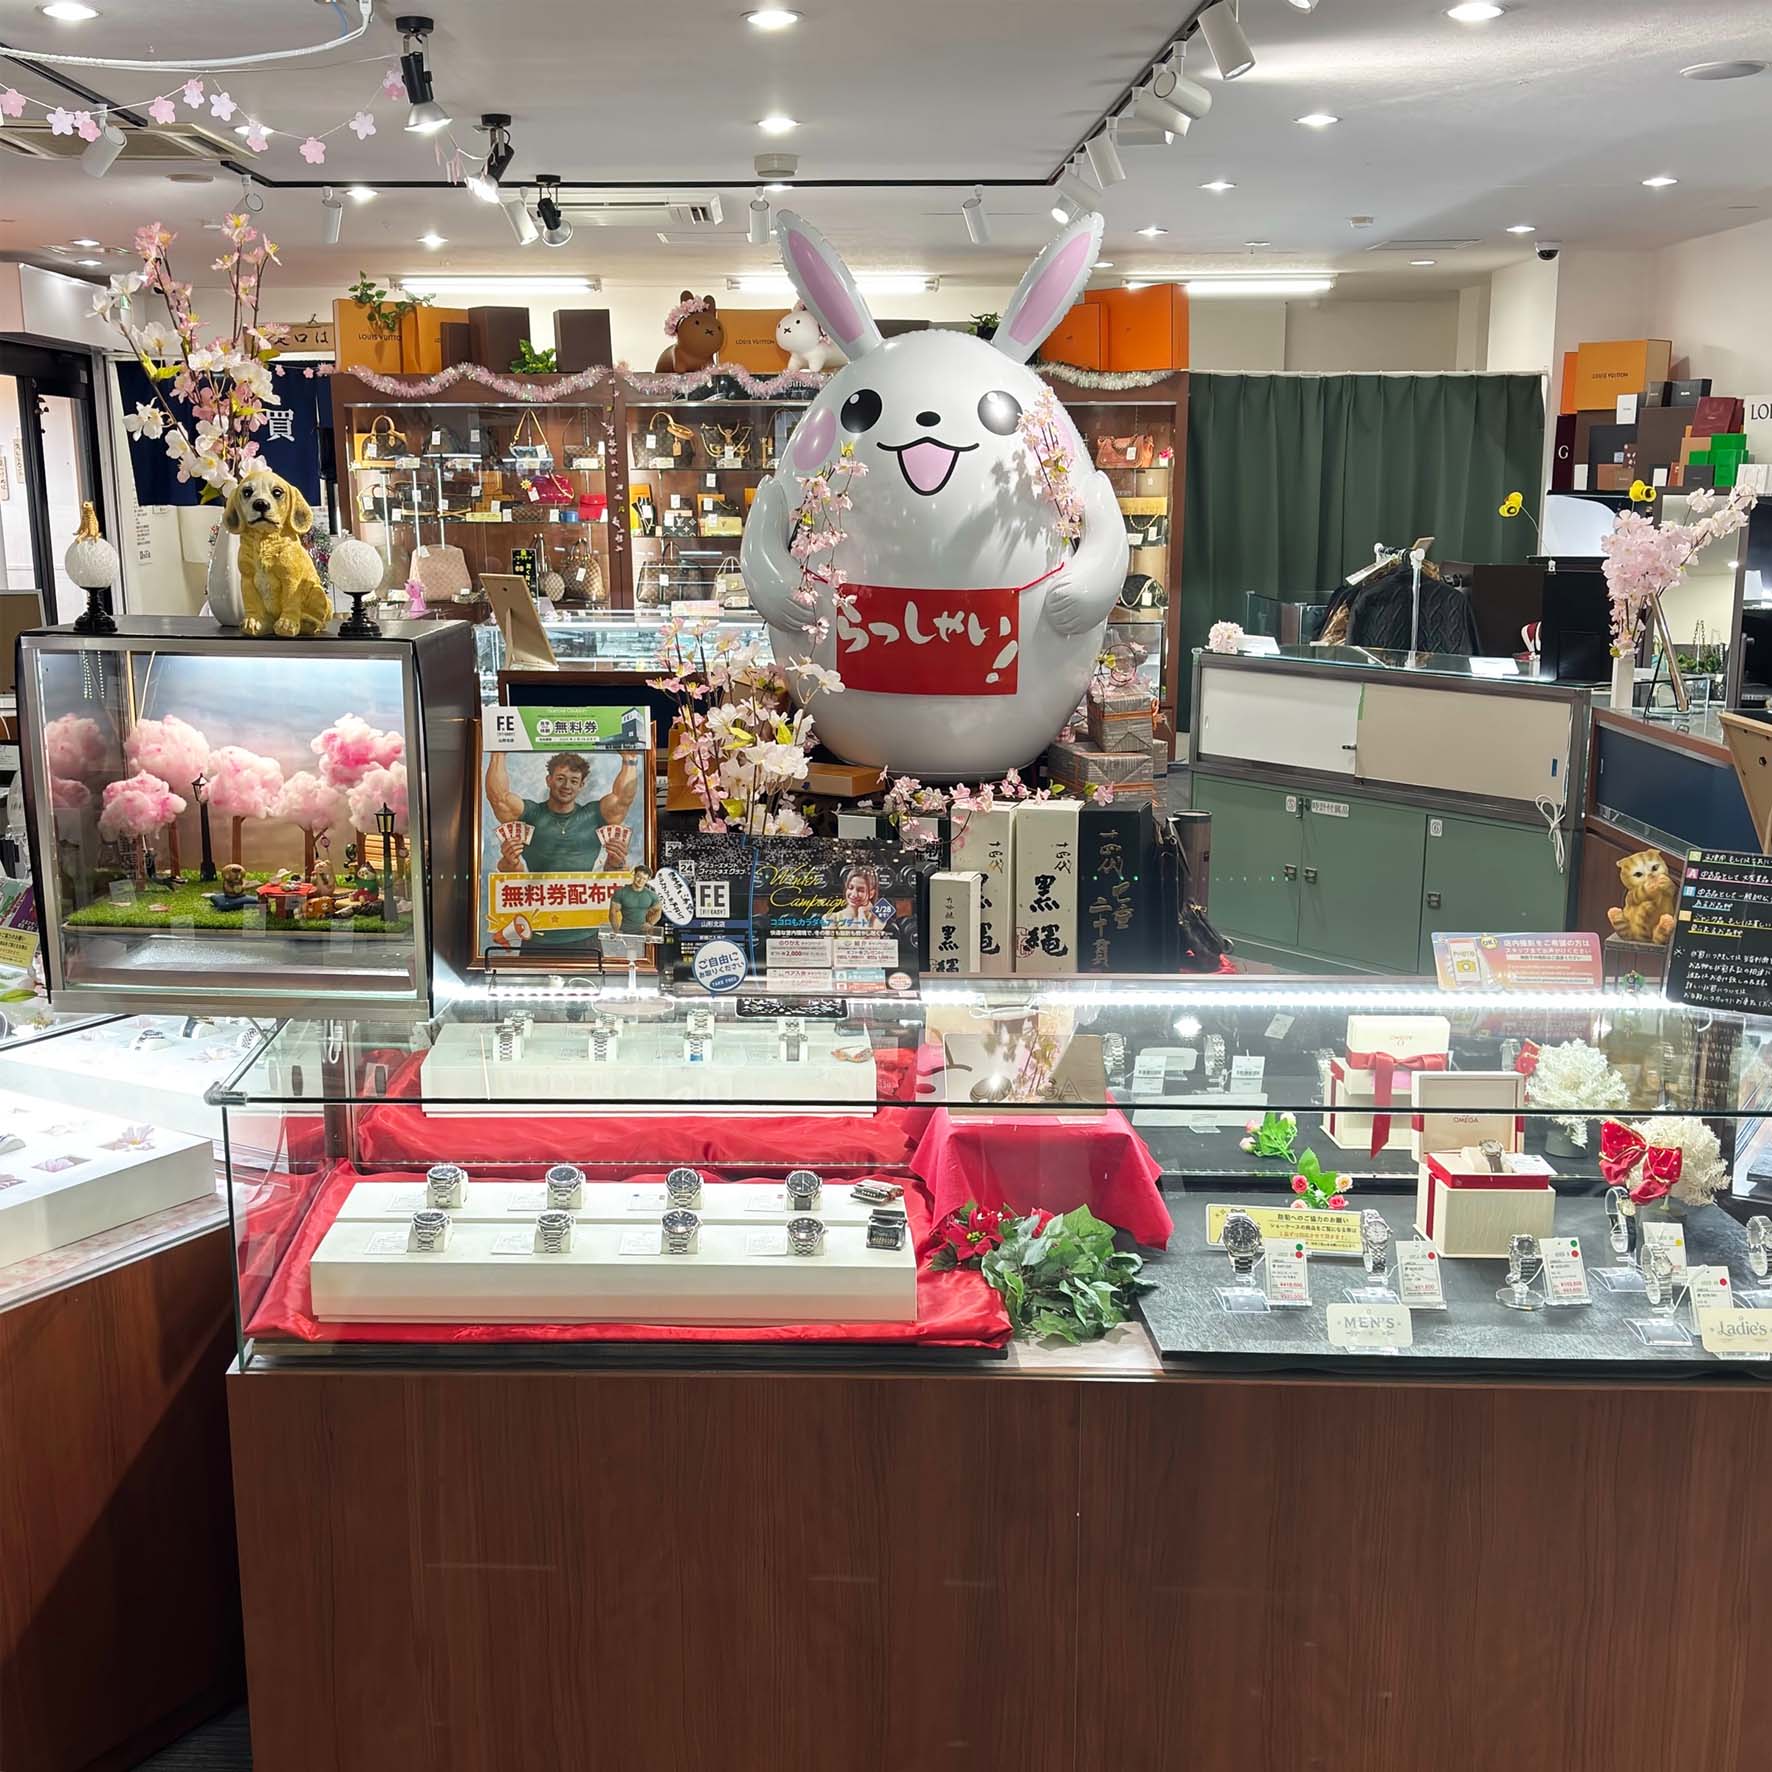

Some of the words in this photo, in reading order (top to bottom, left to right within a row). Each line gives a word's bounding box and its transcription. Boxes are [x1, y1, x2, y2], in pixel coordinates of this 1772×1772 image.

[358, 333, 379, 341] LOUIS
[383, 334, 401, 342] VUITTO
[1750, 403, 1772, 420] LO
[554, 720, 598, 733] 無料券
[680, 864, 693, 873] 24
[769, 886, 847, 914] Campaign
[698, 951, 739, 969] ご自由に
[1453, 1116, 1479, 1124] OMEGA
[1344, 1316, 1395, 1329] MEN'S
[1718, 1320, 1768, 1337] Ladie's
